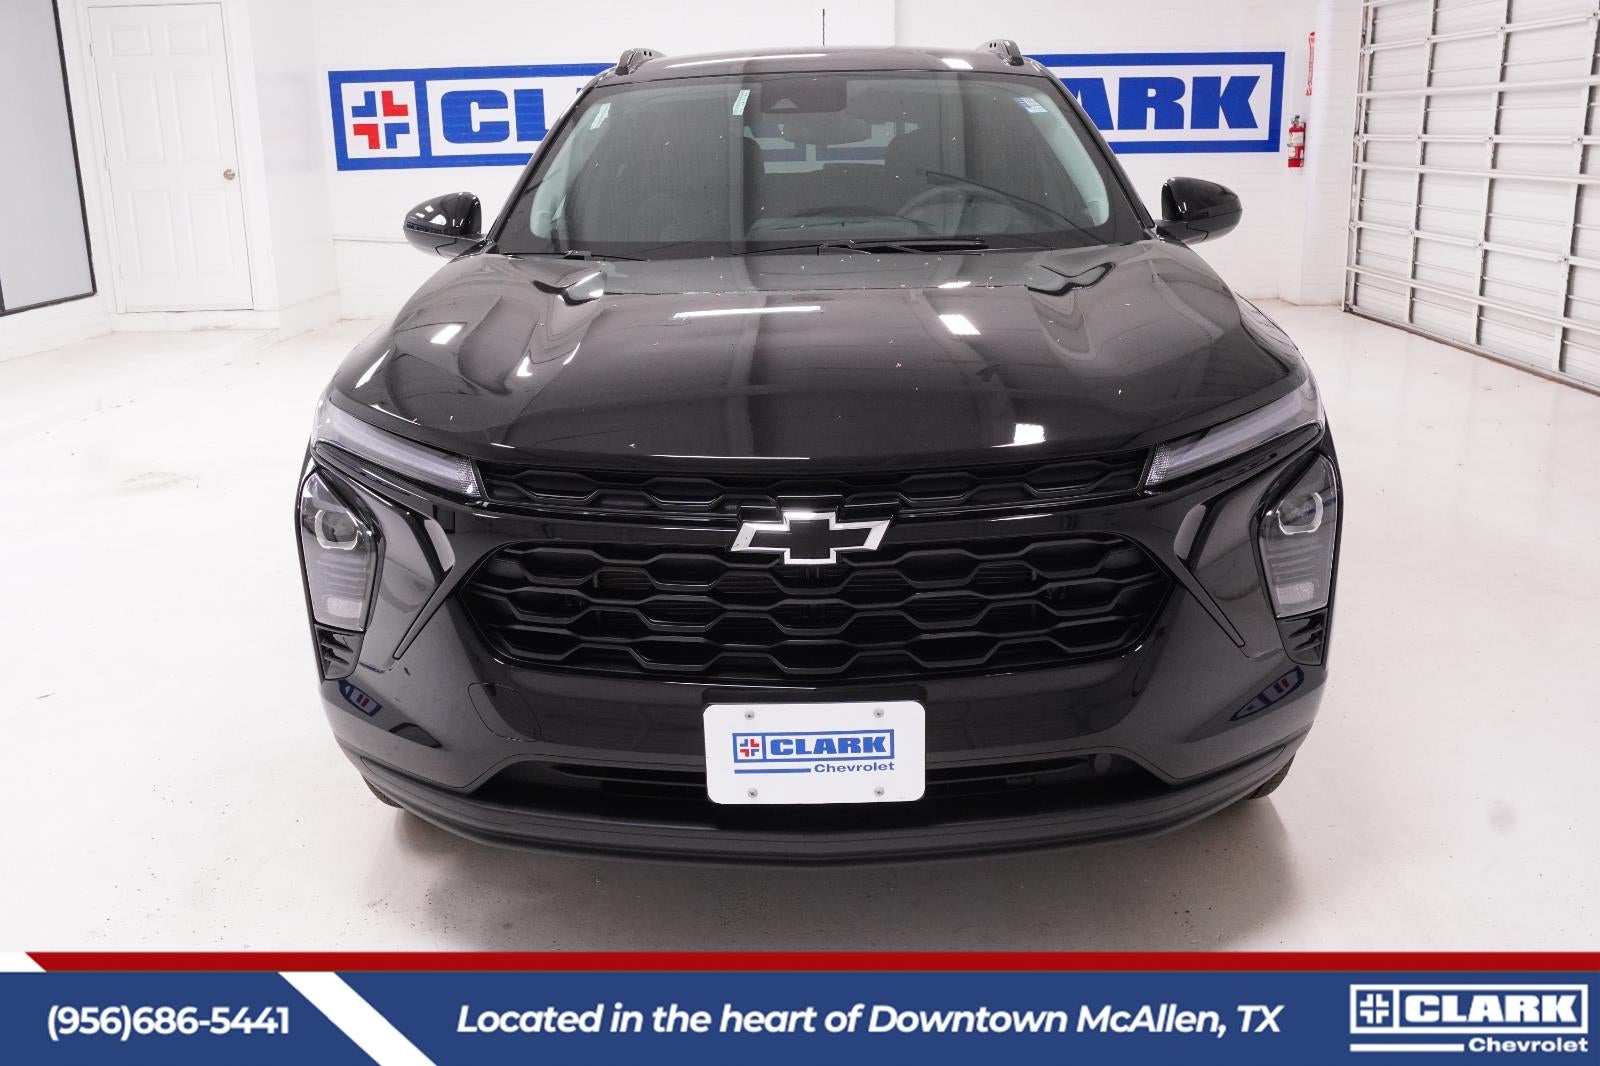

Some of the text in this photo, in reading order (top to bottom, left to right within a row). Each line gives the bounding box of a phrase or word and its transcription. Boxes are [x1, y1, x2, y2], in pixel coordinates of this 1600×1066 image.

[441, 87, 583, 144] CL
[770, 736, 887, 756] CLARK
[814, 762, 895, 773] Chevrolet
